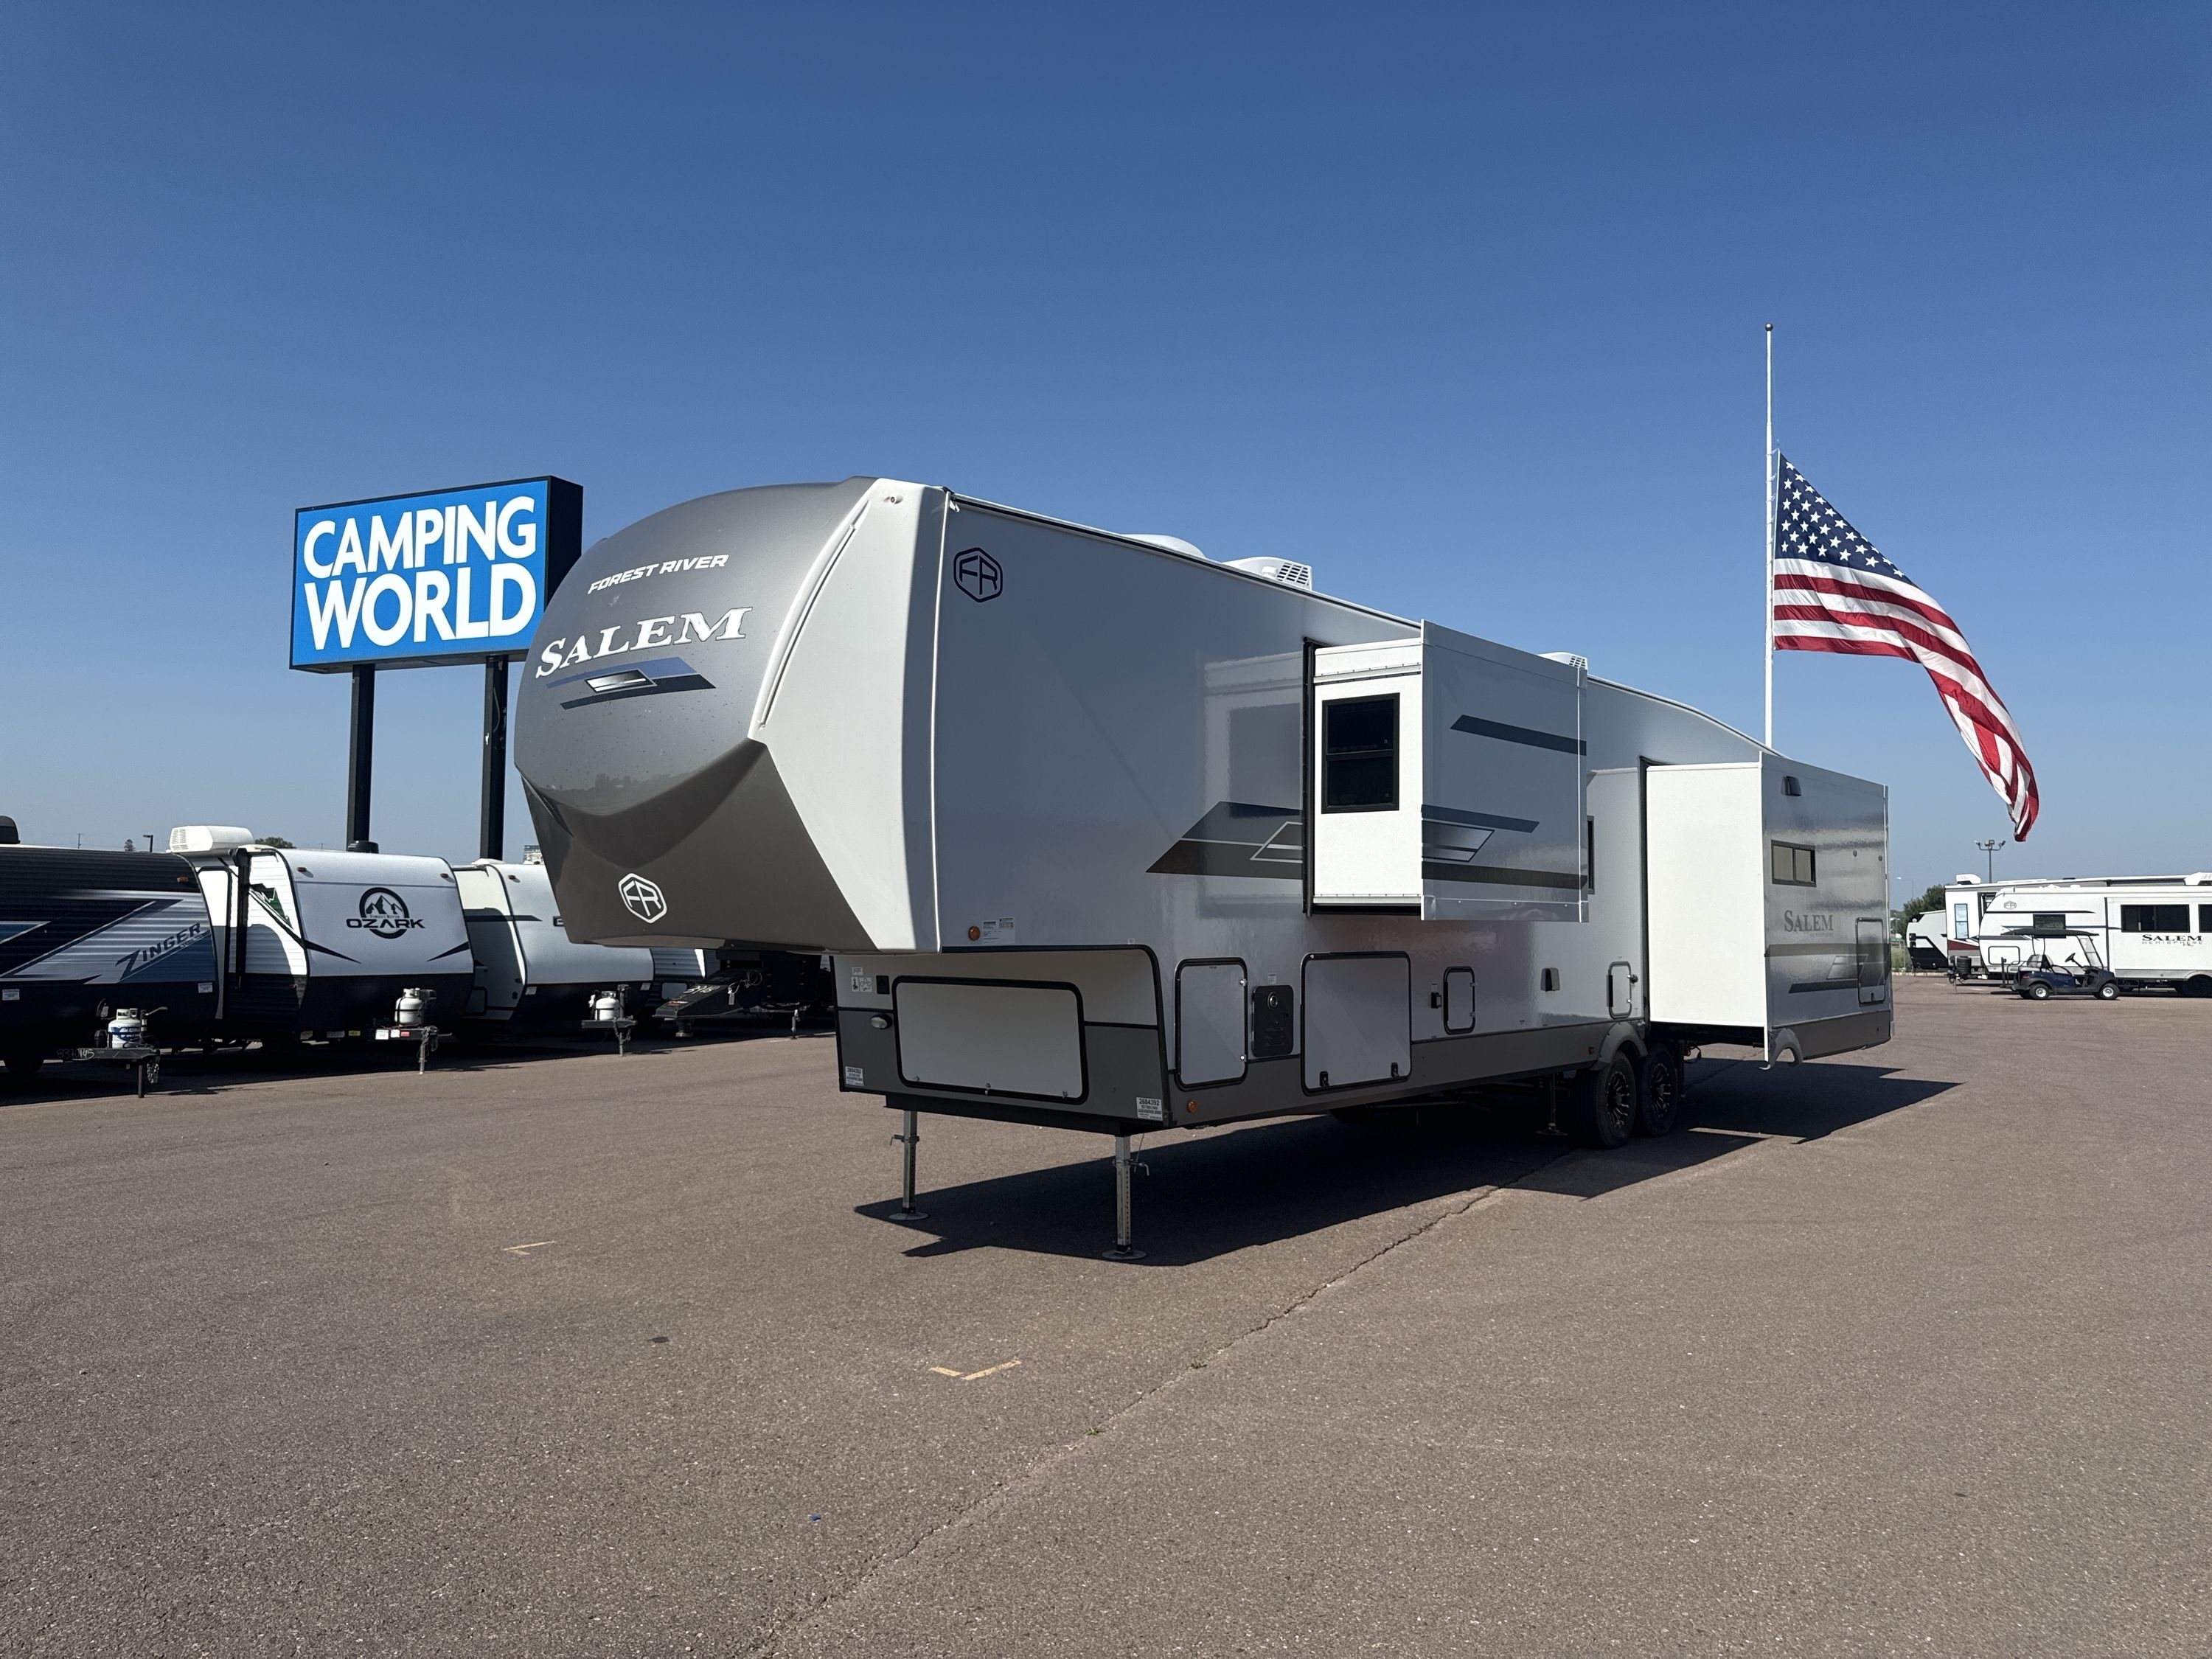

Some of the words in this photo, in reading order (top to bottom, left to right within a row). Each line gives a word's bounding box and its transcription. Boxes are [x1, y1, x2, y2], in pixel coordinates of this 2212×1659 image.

[303, 495, 537, 580] CAMPING
[588, 563, 659, 594] FOREST
[659, 554, 729, 574] RIVER
[303, 562, 537, 651] WORLD
[535, 606, 753, 679] SALEM
[346, 918, 425, 929] OZARK
[1784, 909, 1834, 932] SALEM
[2142, 933, 2202, 942] SALEM
[115, 922, 203, 980] ZINGER
